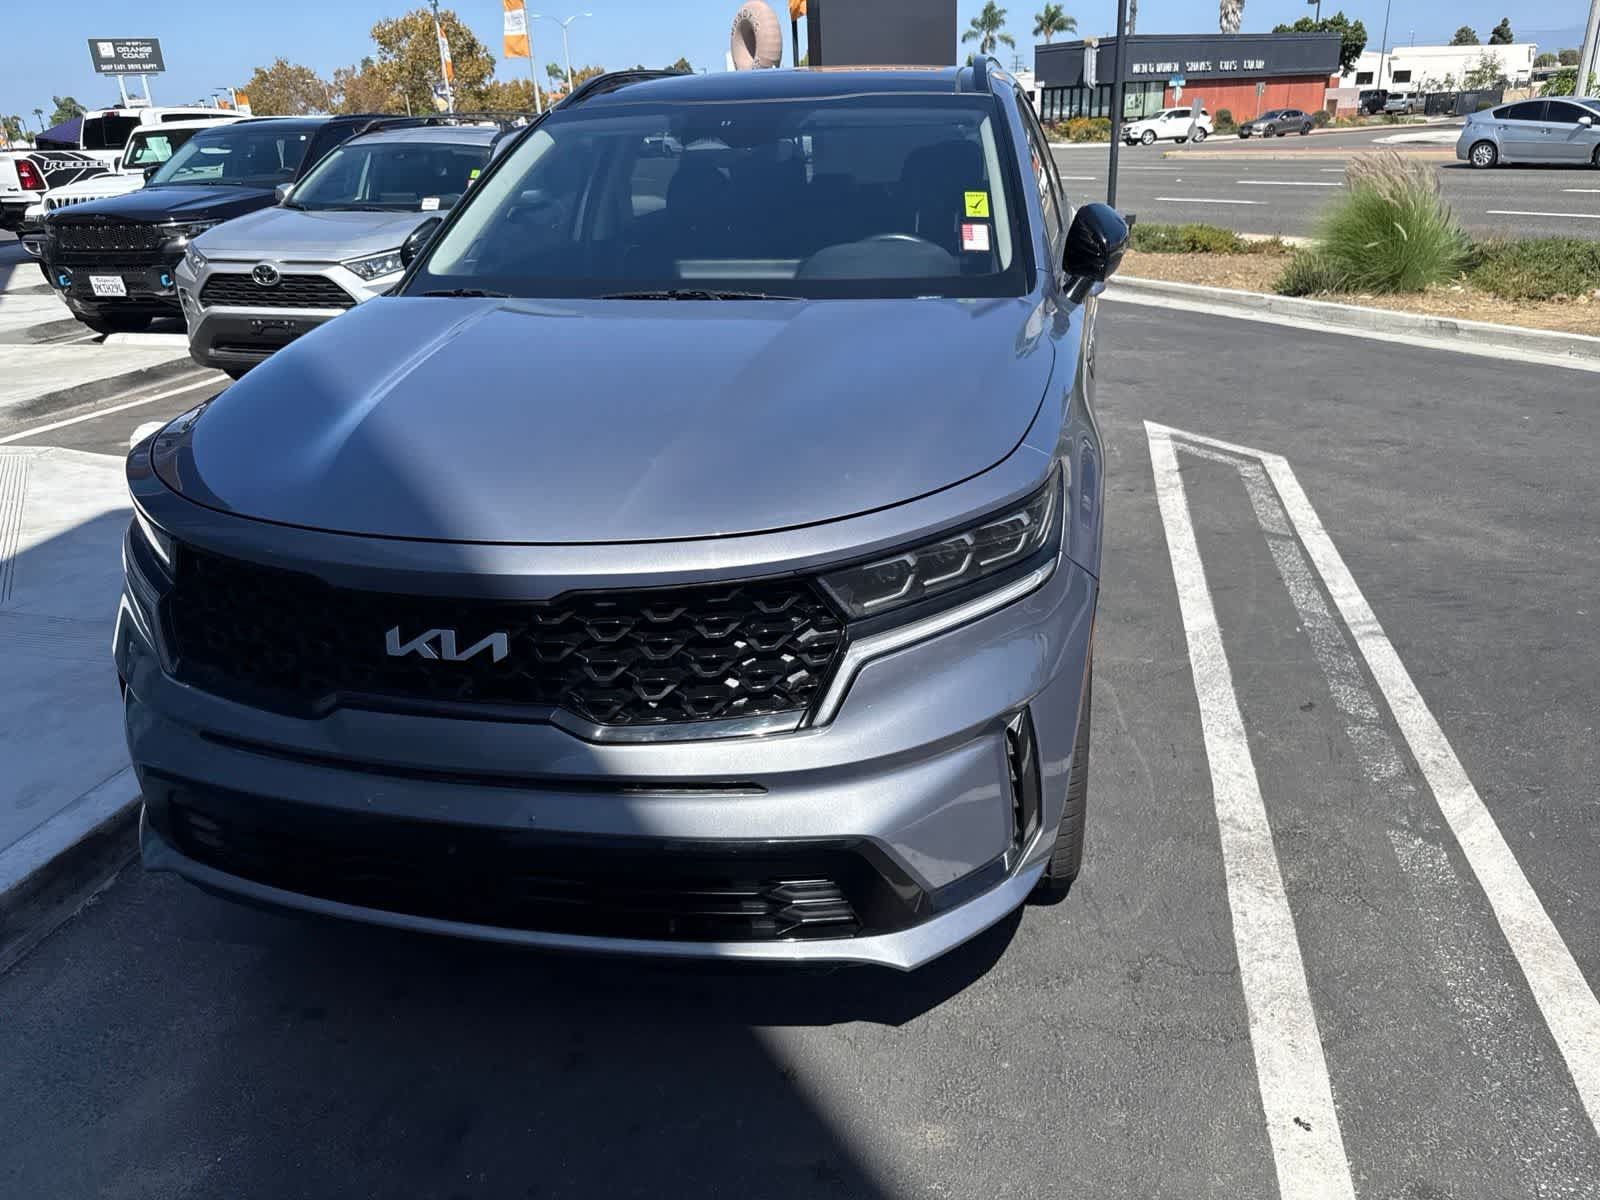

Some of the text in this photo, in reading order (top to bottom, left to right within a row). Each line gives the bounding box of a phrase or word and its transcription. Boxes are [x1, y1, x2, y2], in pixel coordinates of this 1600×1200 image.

[1219, 60, 1238, 71] CUTS
[43, 159, 104, 171] REBEL
[385, 624, 509, 664] KIA
